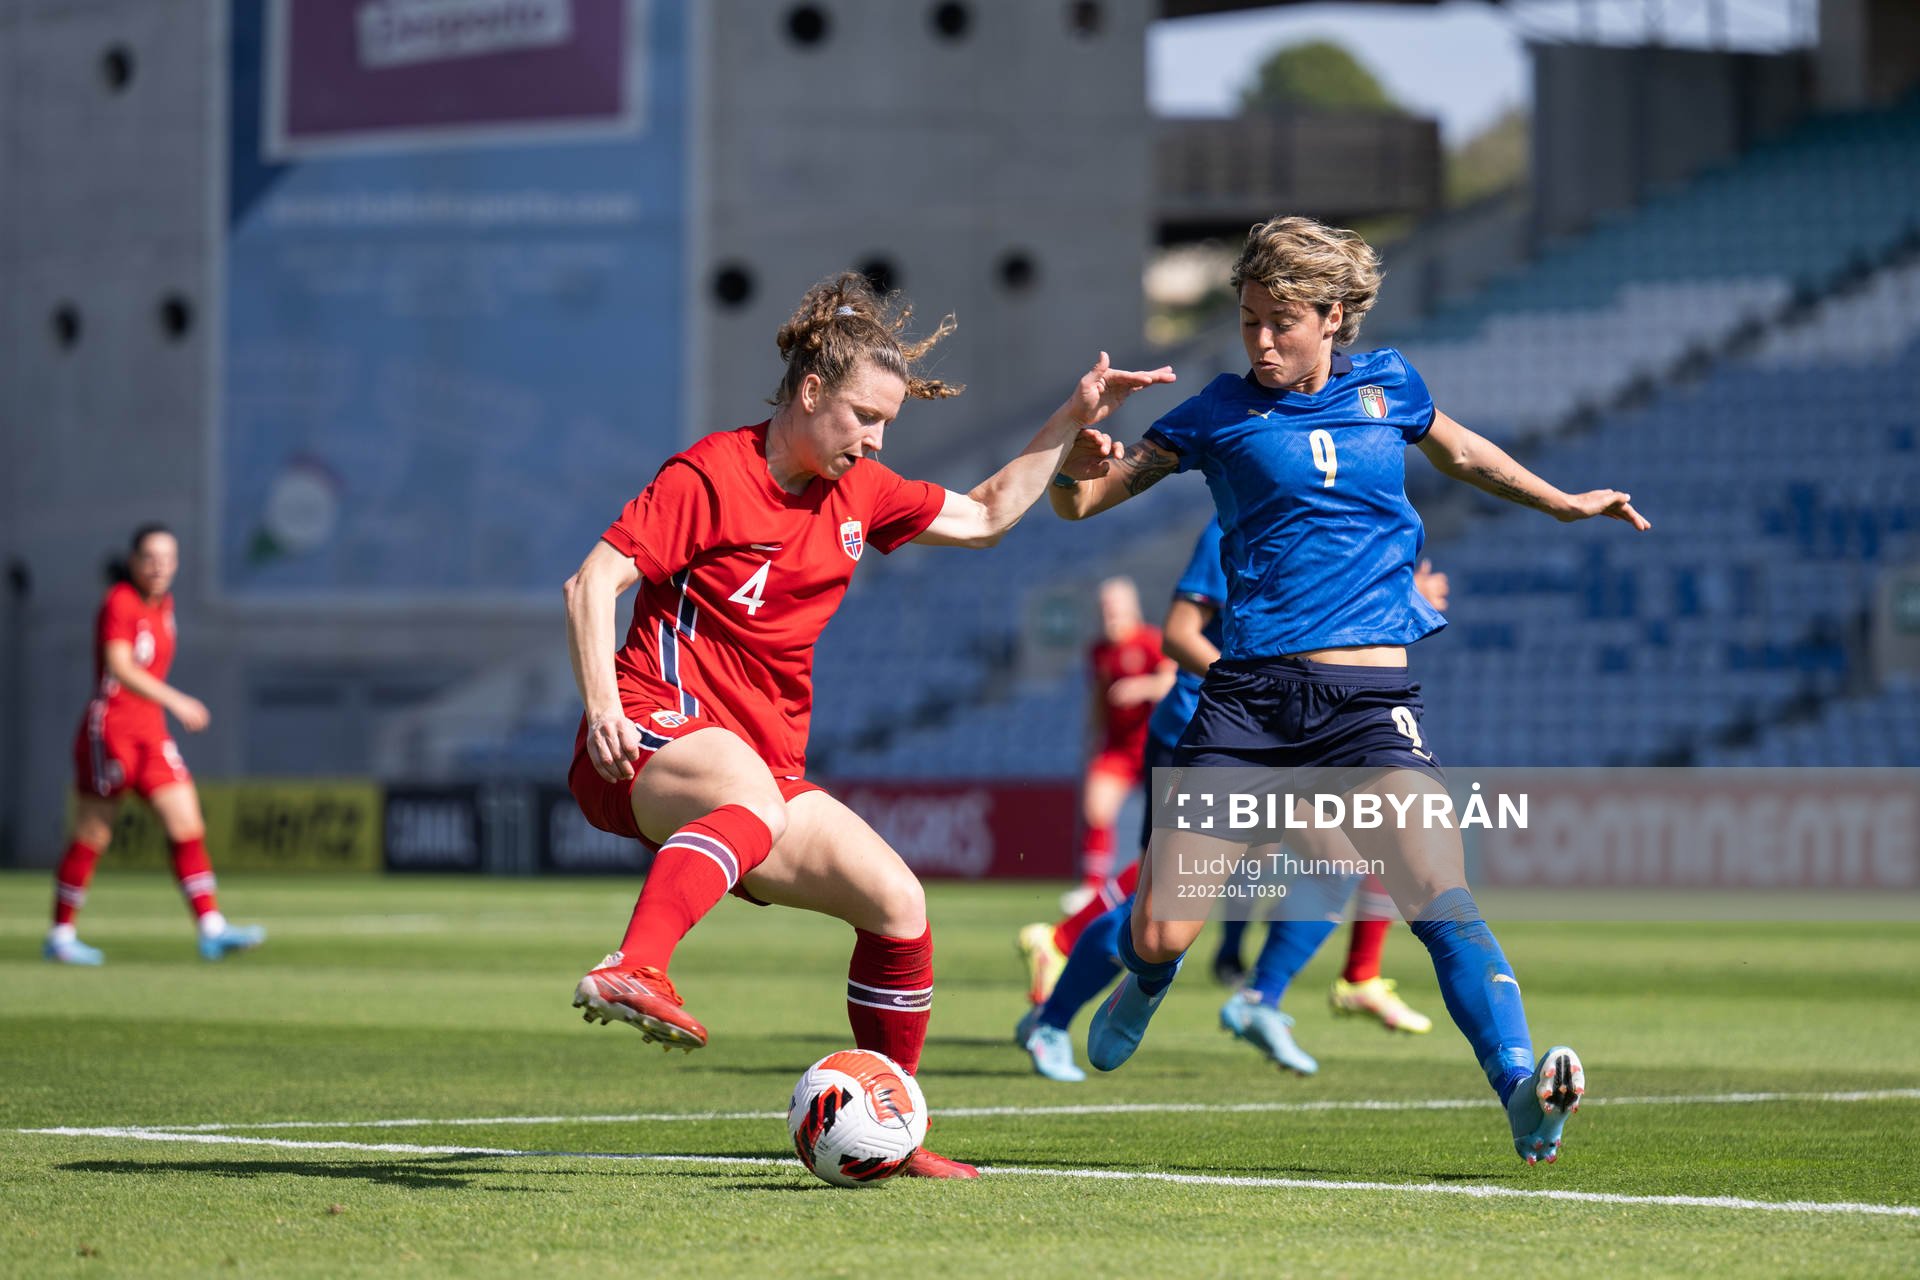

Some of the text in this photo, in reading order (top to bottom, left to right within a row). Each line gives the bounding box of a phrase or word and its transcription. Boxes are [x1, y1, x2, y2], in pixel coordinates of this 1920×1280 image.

[1309, 429, 1338, 488] 9
[728, 560, 771, 616] 4
[1391, 706, 1422, 748] 9
